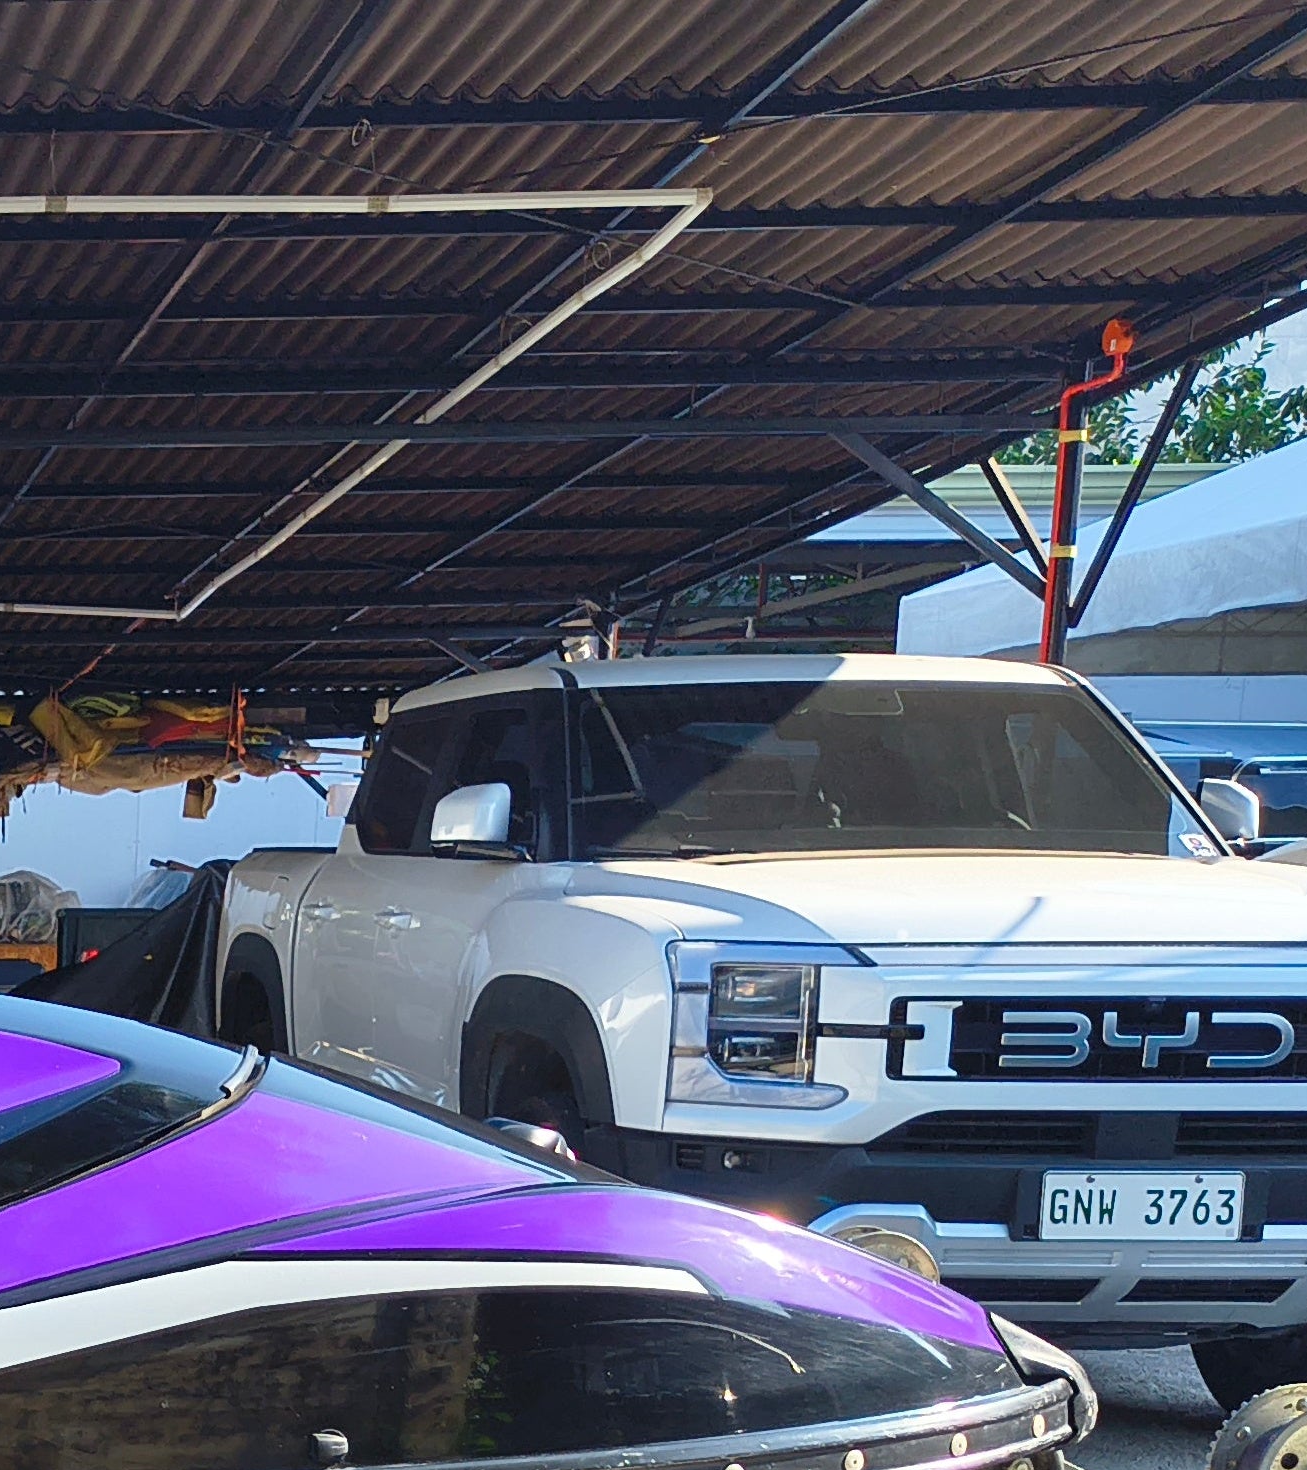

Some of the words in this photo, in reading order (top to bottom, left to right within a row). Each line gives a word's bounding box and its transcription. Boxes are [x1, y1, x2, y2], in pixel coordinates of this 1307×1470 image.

[998, 1011, 1294, 1068] BYD
[1049, 1188, 1117, 1225] GNW
[1144, 1189, 1236, 1226] 3763
